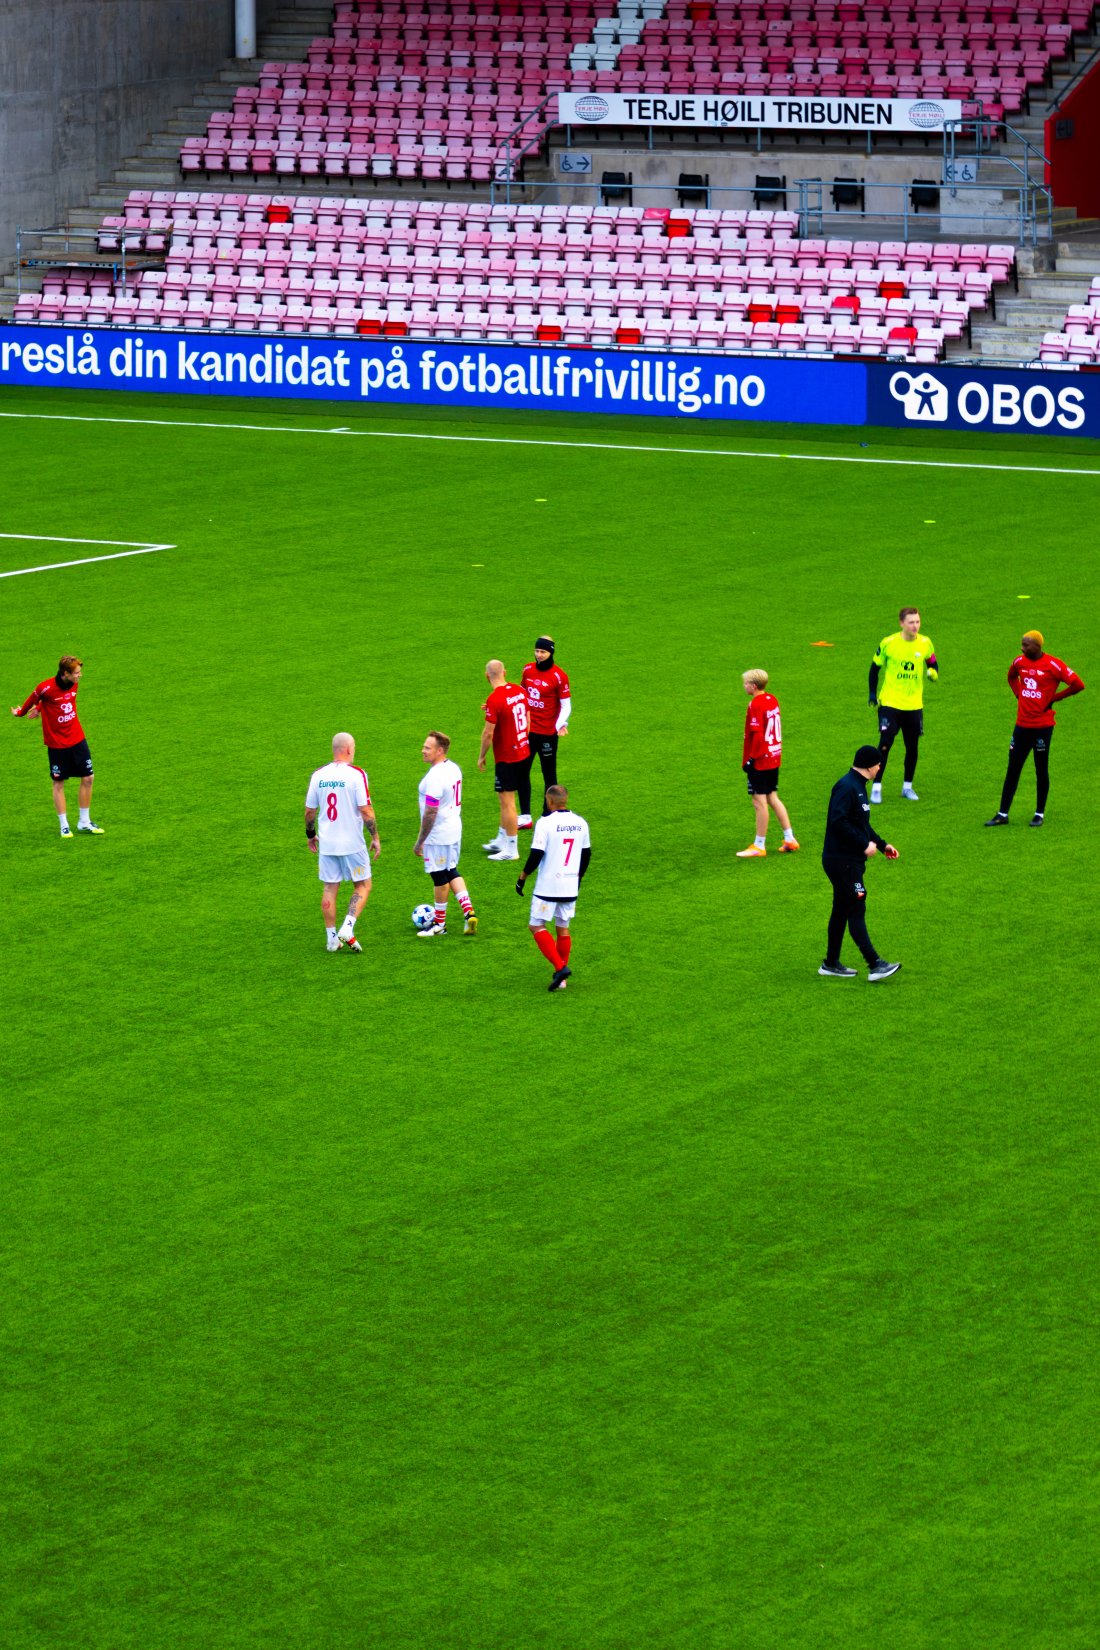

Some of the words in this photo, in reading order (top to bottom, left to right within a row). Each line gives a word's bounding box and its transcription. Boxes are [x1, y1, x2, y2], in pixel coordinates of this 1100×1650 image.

[623, 99, 695, 120] TERJE
[704, 100, 764, 122] HØILI
[773, 102, 892, 124] TRIBUNEN
[109, 338, 167, 379] din
[178, 341, 350, 387] kandidat
[361, 346, 410, 396] på
[419, 350, 766, 413] fotballfrivillig.no
[957, 381, 1086, 430] OBOS
[897, 672, 918, 680] OBOS
[1022, 689, 1042, 699] OBOS
[512, 703, 527, 733] 13
[765, 713, 782, 744] 40
[319, 780, 346, 789] Europris
[327, 793, 338, 822] 8
[556, 825, 582, 833] Europris
[563, 839, 575, 867] 7
